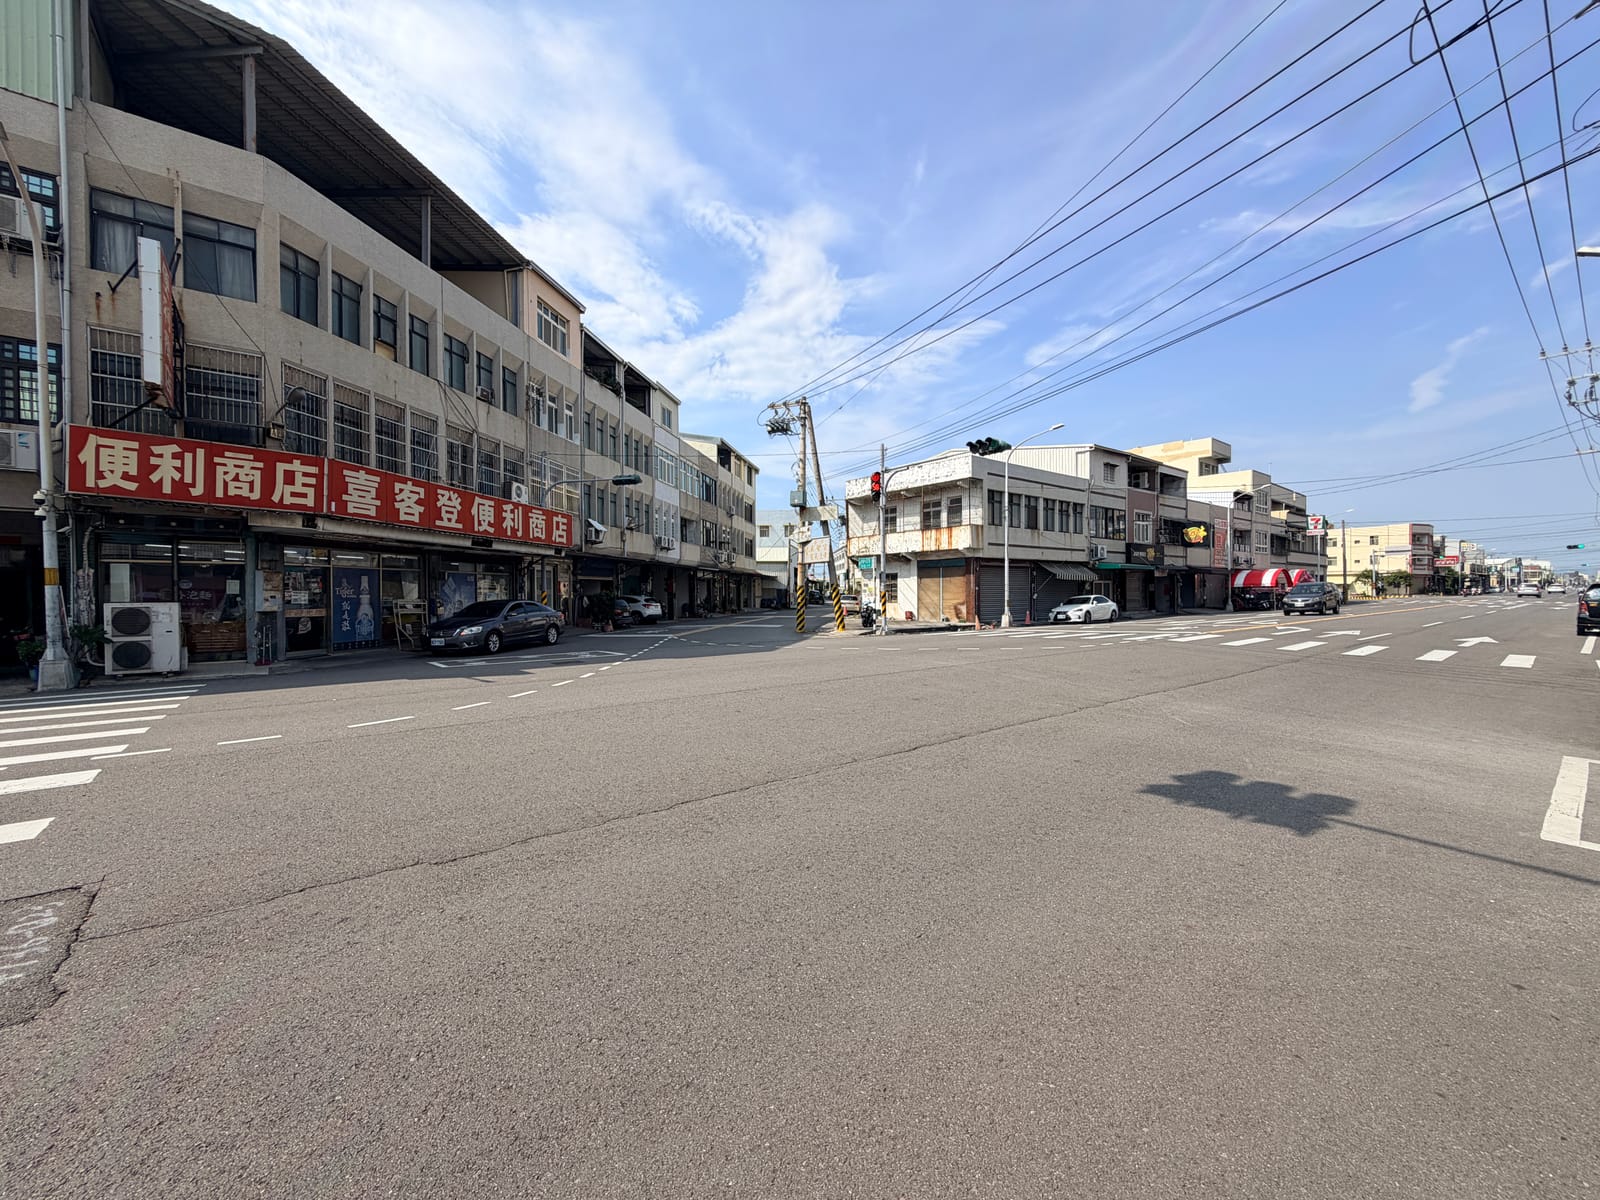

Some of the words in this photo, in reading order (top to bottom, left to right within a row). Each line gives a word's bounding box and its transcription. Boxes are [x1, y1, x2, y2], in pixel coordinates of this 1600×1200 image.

[78, 433, 318, 507] 便利商店
[341, 470, 568, 545] 喜客登便利商店
